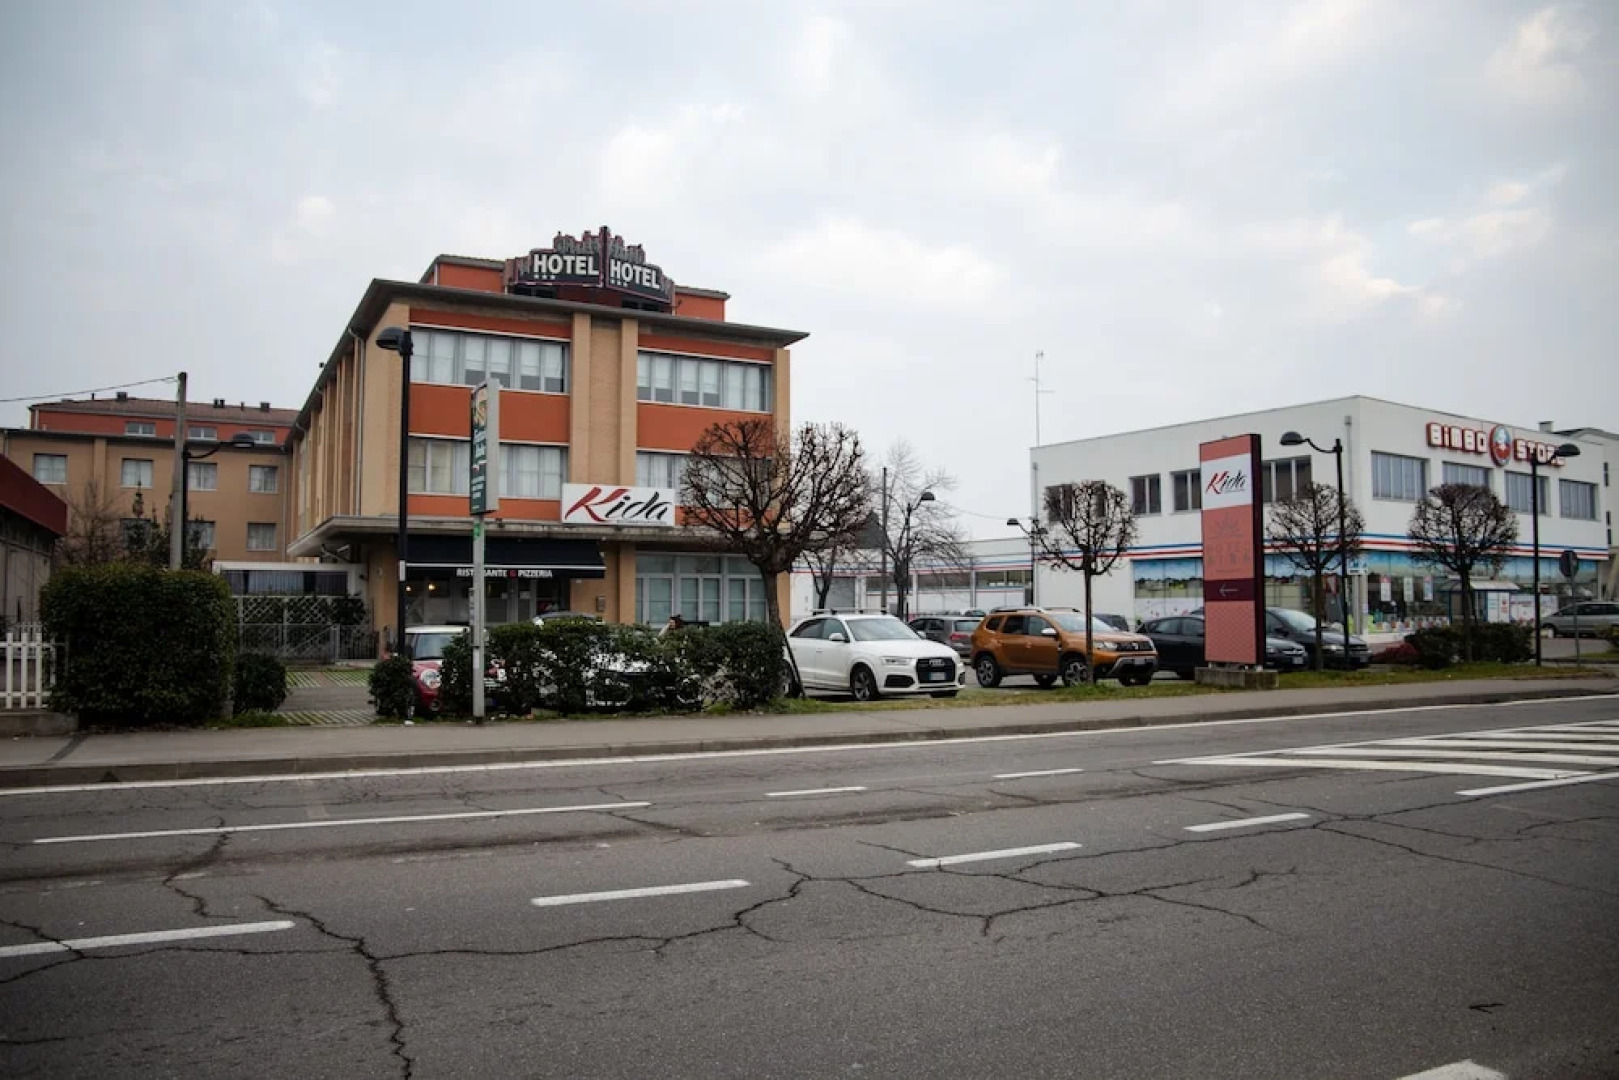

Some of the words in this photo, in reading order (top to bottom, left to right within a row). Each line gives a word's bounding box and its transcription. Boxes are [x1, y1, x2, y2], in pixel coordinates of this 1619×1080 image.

[533, 253, 600, 276] HOTEL
[609, 258, 661, 289] HOTEL
[1205, 469, 1247, 494] Kida
[564, 486, 672, 522] Kida
[456, 568, 508, 577] RISTANTE
[518, 569, 553, 578] PIZZERIA
